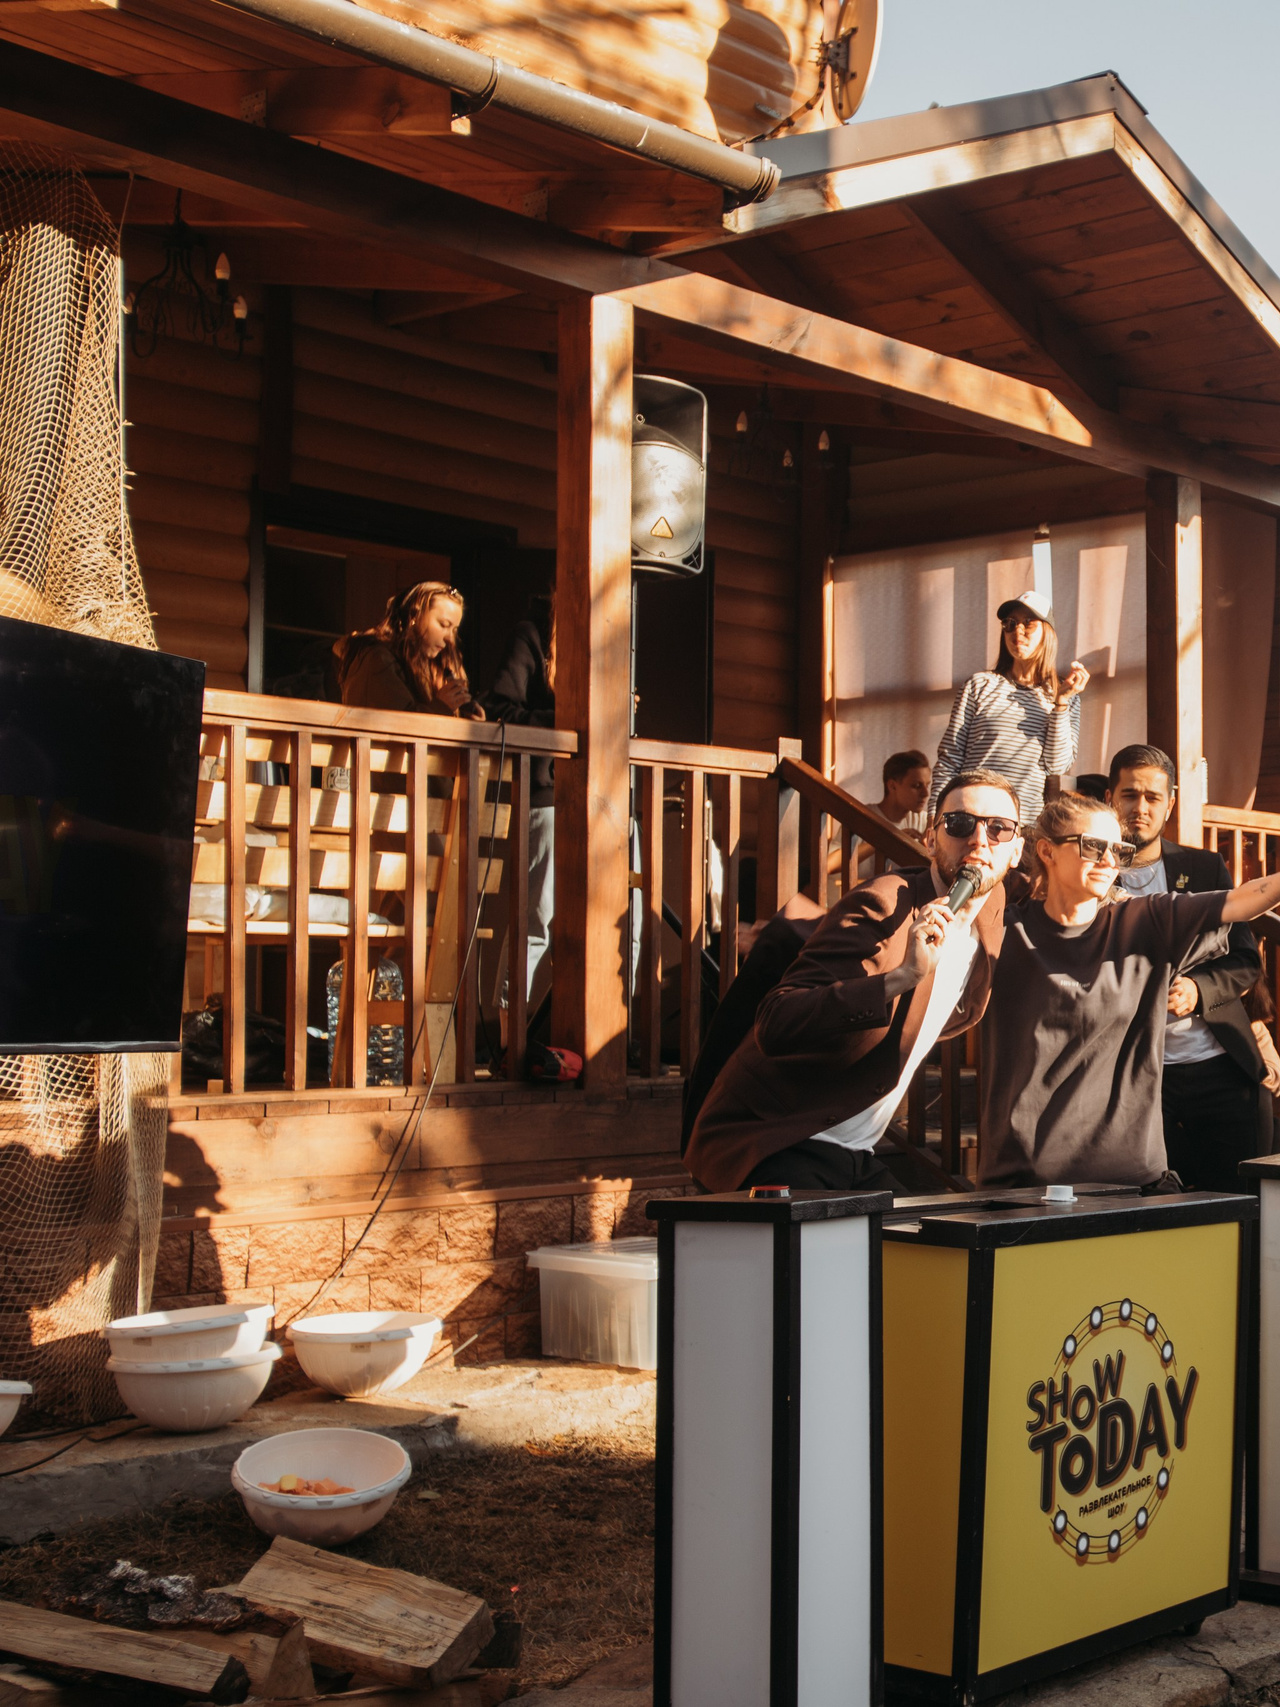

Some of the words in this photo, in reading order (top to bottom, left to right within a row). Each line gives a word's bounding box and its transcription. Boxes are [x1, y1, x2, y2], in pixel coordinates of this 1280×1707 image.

[1026, 1349, 1123, 1433] SHOW
[1028, 1366, 1198, 1512] TODAY
[1079, 1475, 1152, 1517] РАЗВЛЕКАТЕЛЬНОЕ
[1107, 1502, 1125, 1519] ШОУ
